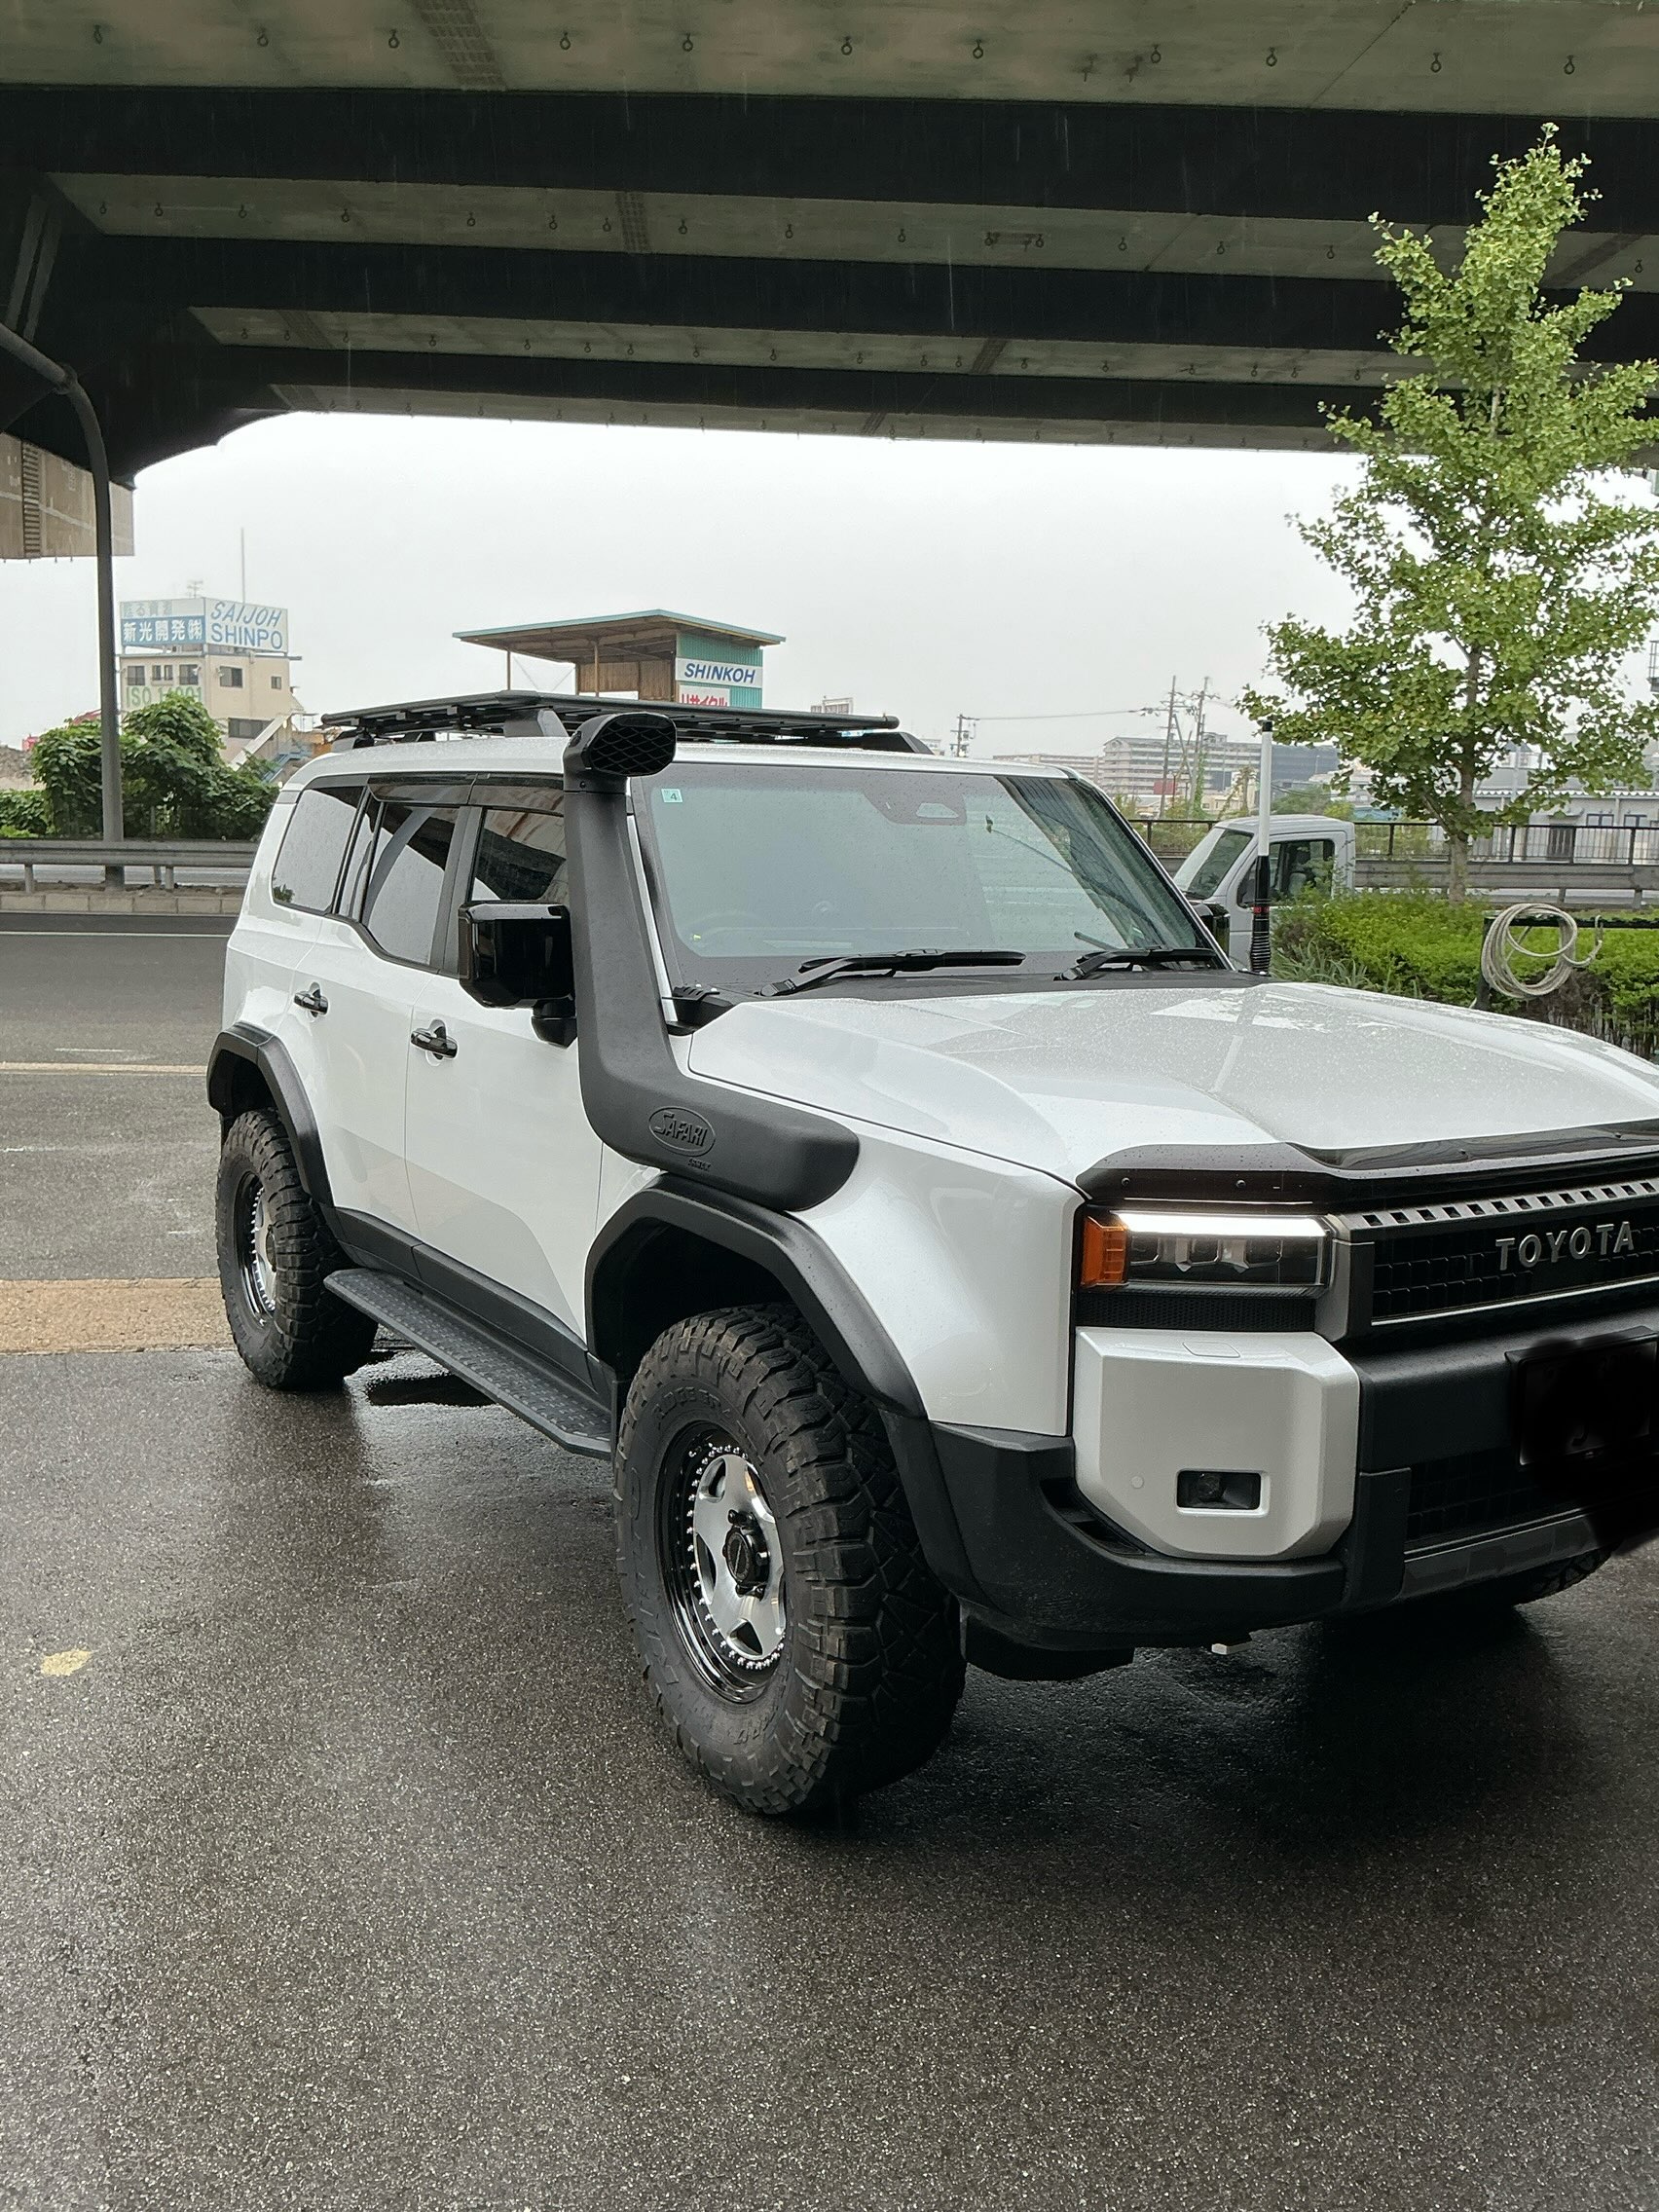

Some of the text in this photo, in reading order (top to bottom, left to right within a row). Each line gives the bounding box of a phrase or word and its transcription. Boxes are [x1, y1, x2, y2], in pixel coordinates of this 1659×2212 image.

[210, 601, 282, 628] SAIJOH
[210, 623, 283, 650] SHINPO
[684, 662, 756, 683] SHINKOH
[127, 686, 152, 708] ISO
[652, 1110, 709, 1147] SAFARI
[1495, 1221, 1635, 1271] TOYOTA
